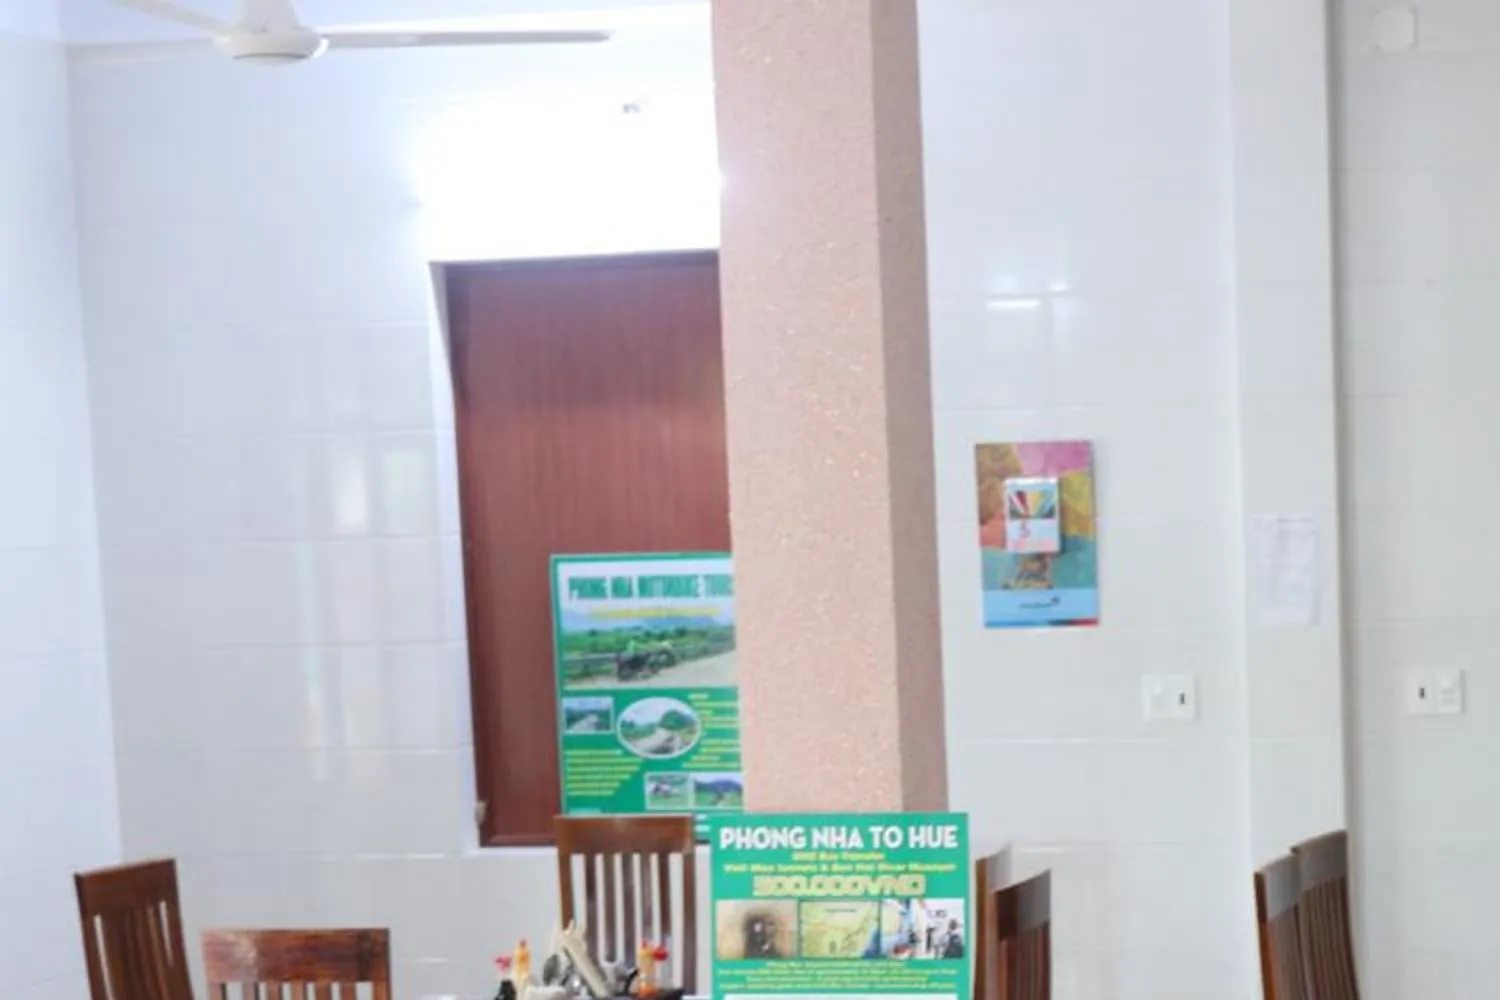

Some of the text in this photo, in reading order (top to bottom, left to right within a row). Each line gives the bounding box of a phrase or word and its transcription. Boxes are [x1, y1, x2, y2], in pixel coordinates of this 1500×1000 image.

[719, 825, 958, 850] PHONG NHA TO HUE
